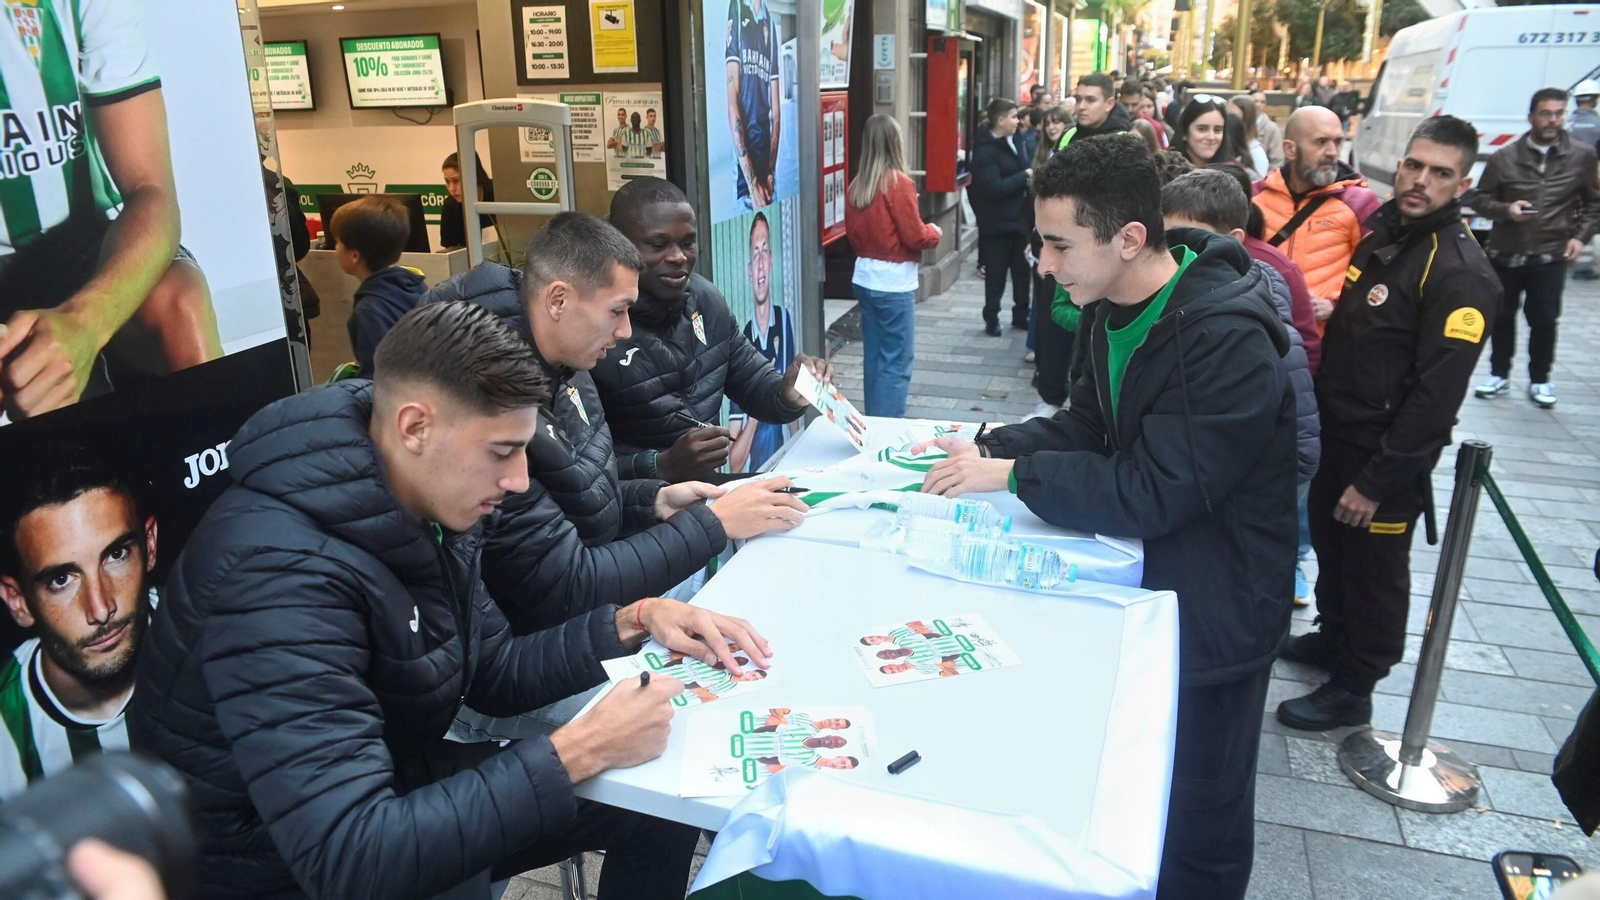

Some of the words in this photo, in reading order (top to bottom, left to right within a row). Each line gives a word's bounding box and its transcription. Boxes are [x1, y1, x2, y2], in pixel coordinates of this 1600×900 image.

[1518, 32, 1550, 43] 672
[1555, 32, 1587, 43] 317
[264, 46, 292, 55] BONADOS
[356, 42, 390, 50] DESCUENTO
[391, 40, 424, 49] ABONADOS
[742, 49, 770, 72] BAHRAIN
[353, 56, 388, 77] 10%
